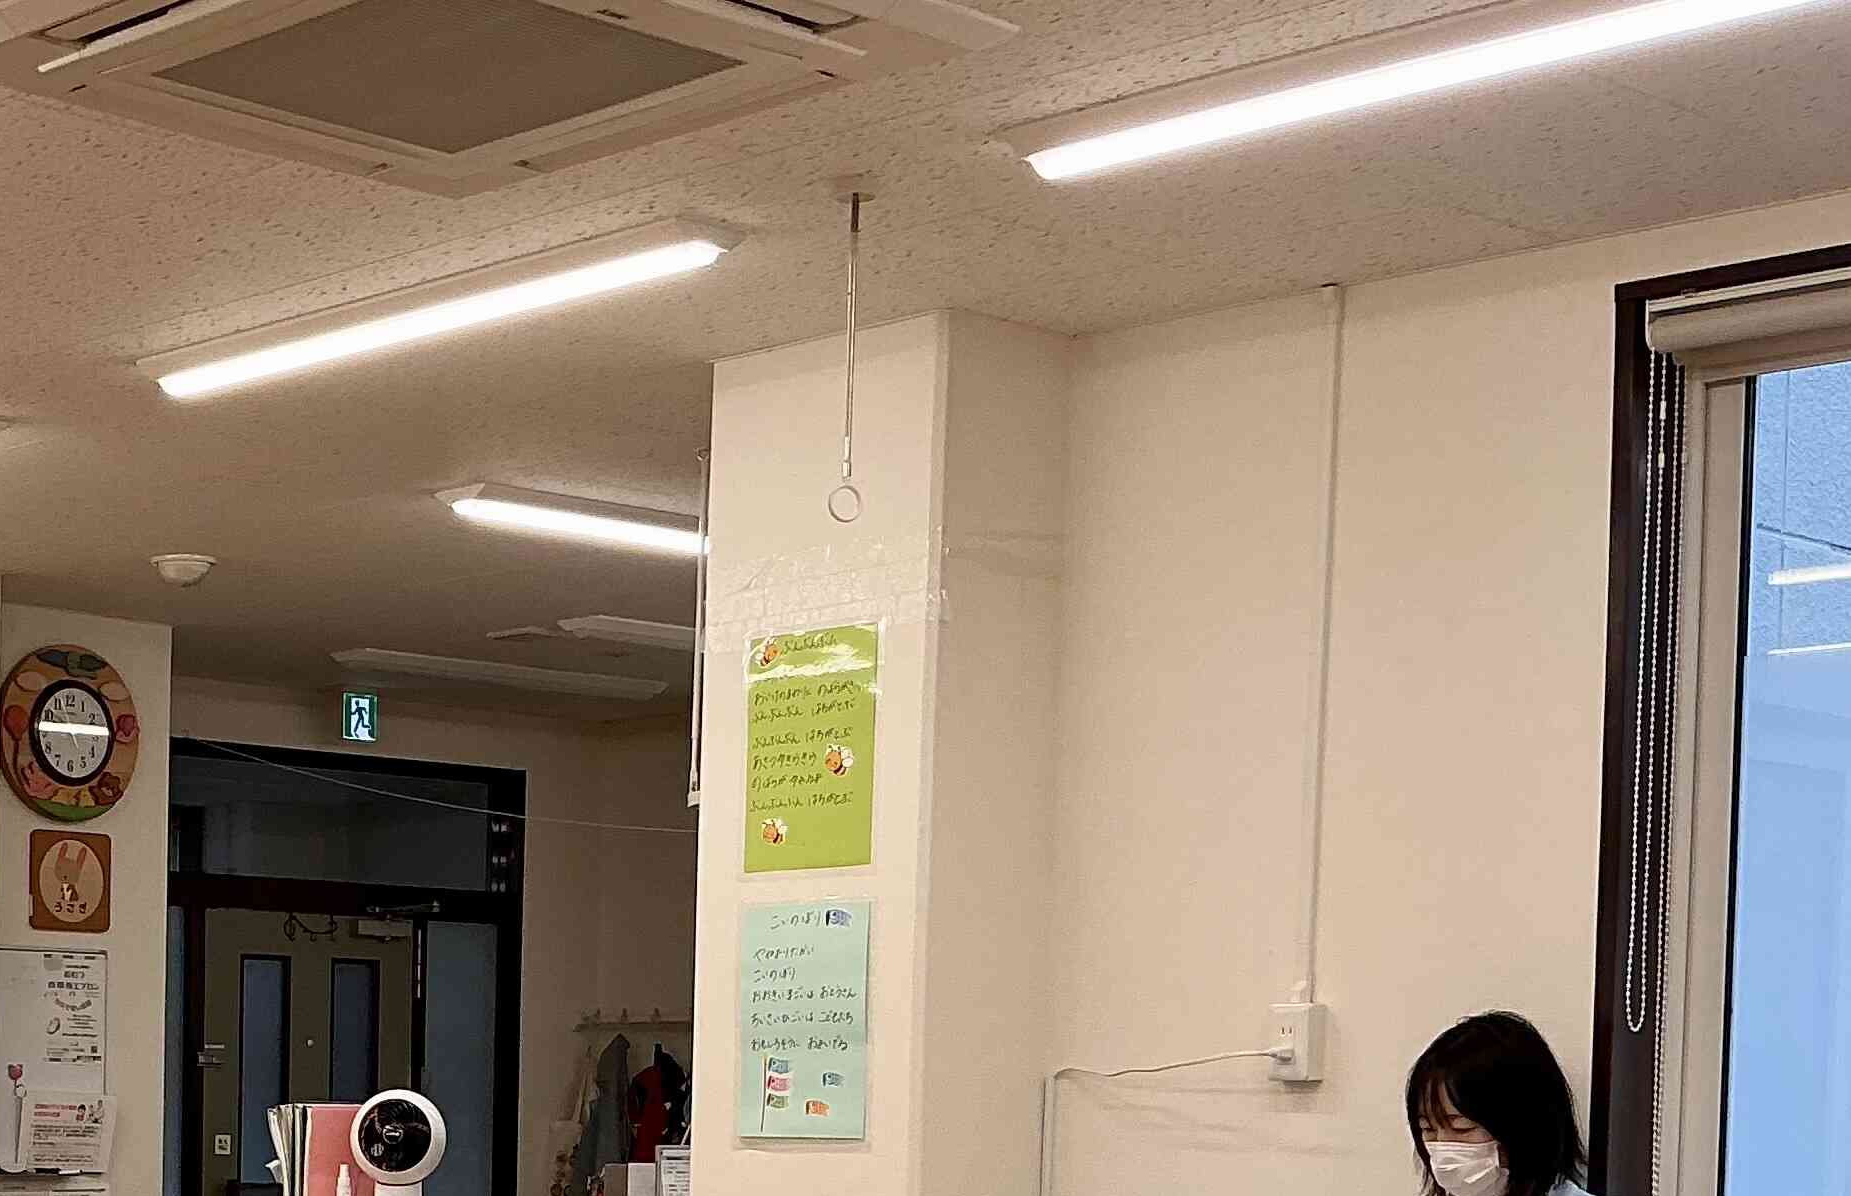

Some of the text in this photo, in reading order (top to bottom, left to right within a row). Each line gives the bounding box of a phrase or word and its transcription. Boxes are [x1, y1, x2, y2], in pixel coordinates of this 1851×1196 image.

[53, 697, 62, 711] 11
[66, 695, 75, 708] 12
[81, 701, 85, 712] 1
[44, 709, 54, 721] 10
[89, 712, 97, 725] 2
[44, 742, 52, 754] 8
[89, 745, 96, 759] 4
[54, 754, 61, 767] 7
[67, 760, 74, 773] 6
[80, 757, 87, 769] 5
[54, 902, 88, 914] うさぎ
[770, 910, 821, 930] こいのぼり
[753, 967, 796, 983] こいのぼり
